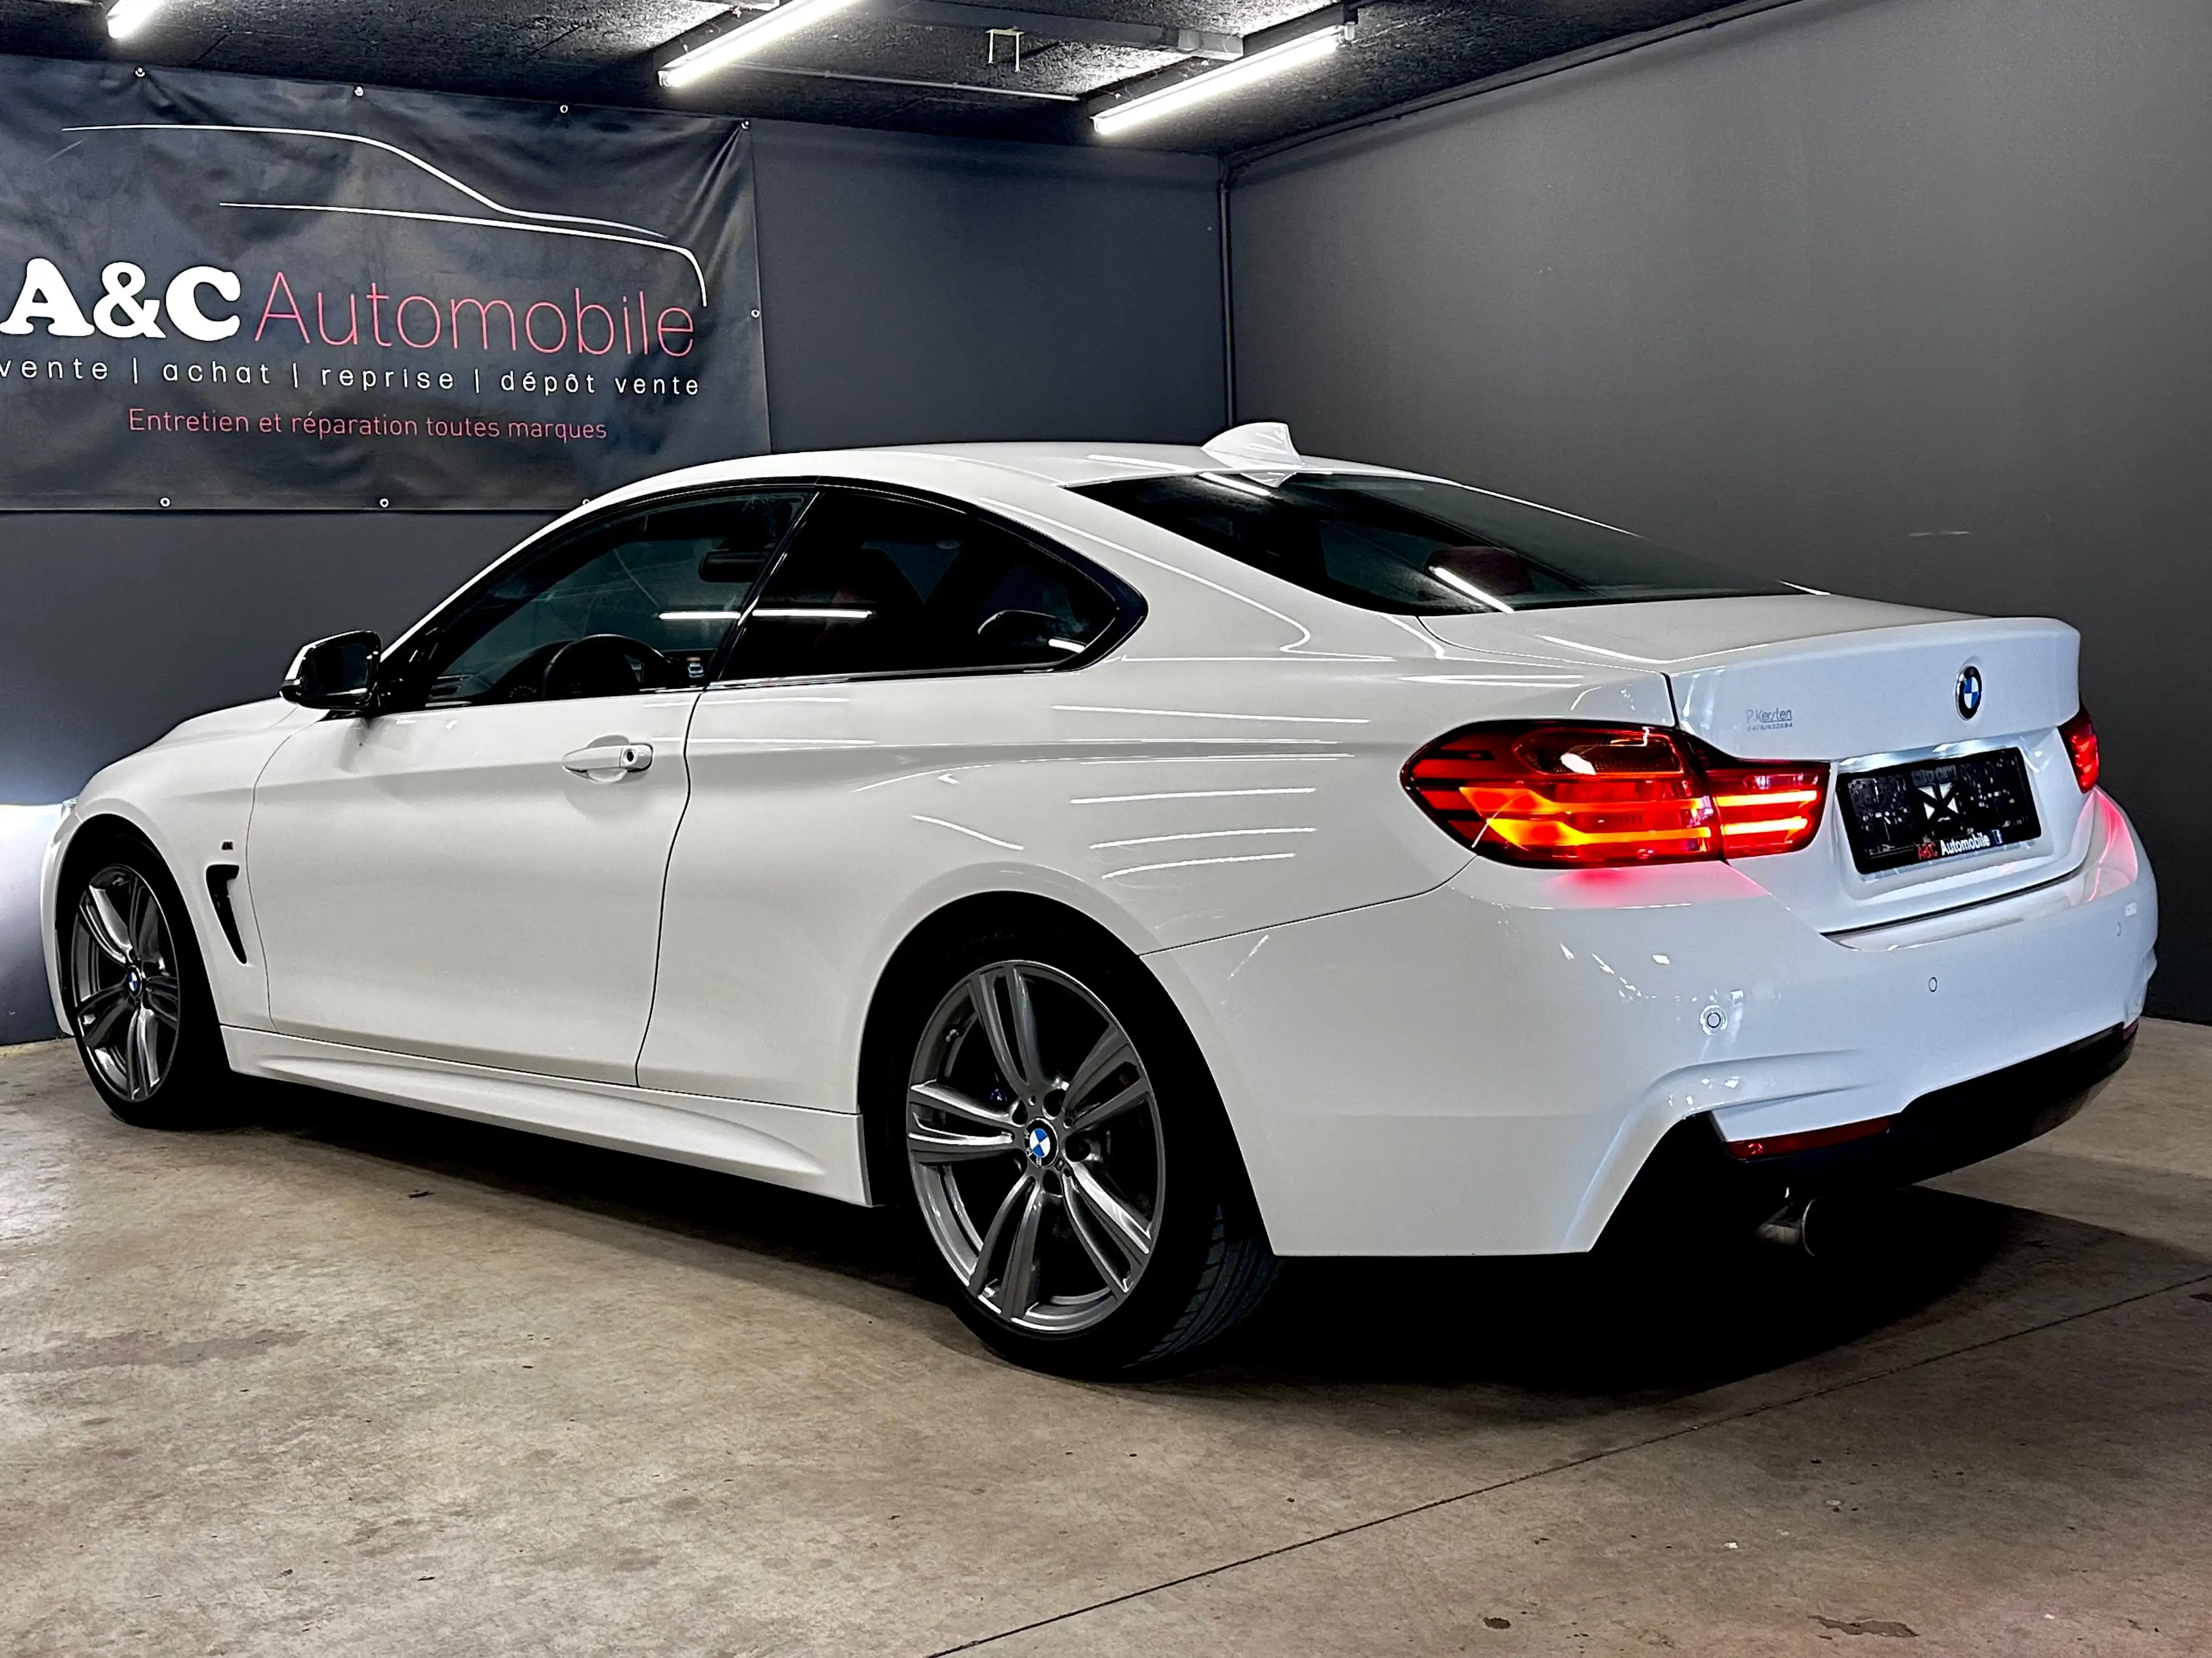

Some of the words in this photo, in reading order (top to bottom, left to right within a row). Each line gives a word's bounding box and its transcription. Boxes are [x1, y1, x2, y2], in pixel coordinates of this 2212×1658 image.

[0, 257, 241, 341] A&C
[255, 272, 694, 357] Automobile
[0, 358, 108, 380] vente
[163, 361, 270, 384] achat
[322, 369, 453, 391] reprise
[501, 370, 595, 396] dépôt
[615, 376, 698, 395] vente
[129, 408, 249, 432] Entretien
[259, 412, 281, 433] et
[291, 411, 417, 439] réparation
[426, 416, 499, 438] toutes
[508, 422, 607, 443] marques
[1940, 832, 1990, 856] Automobile
